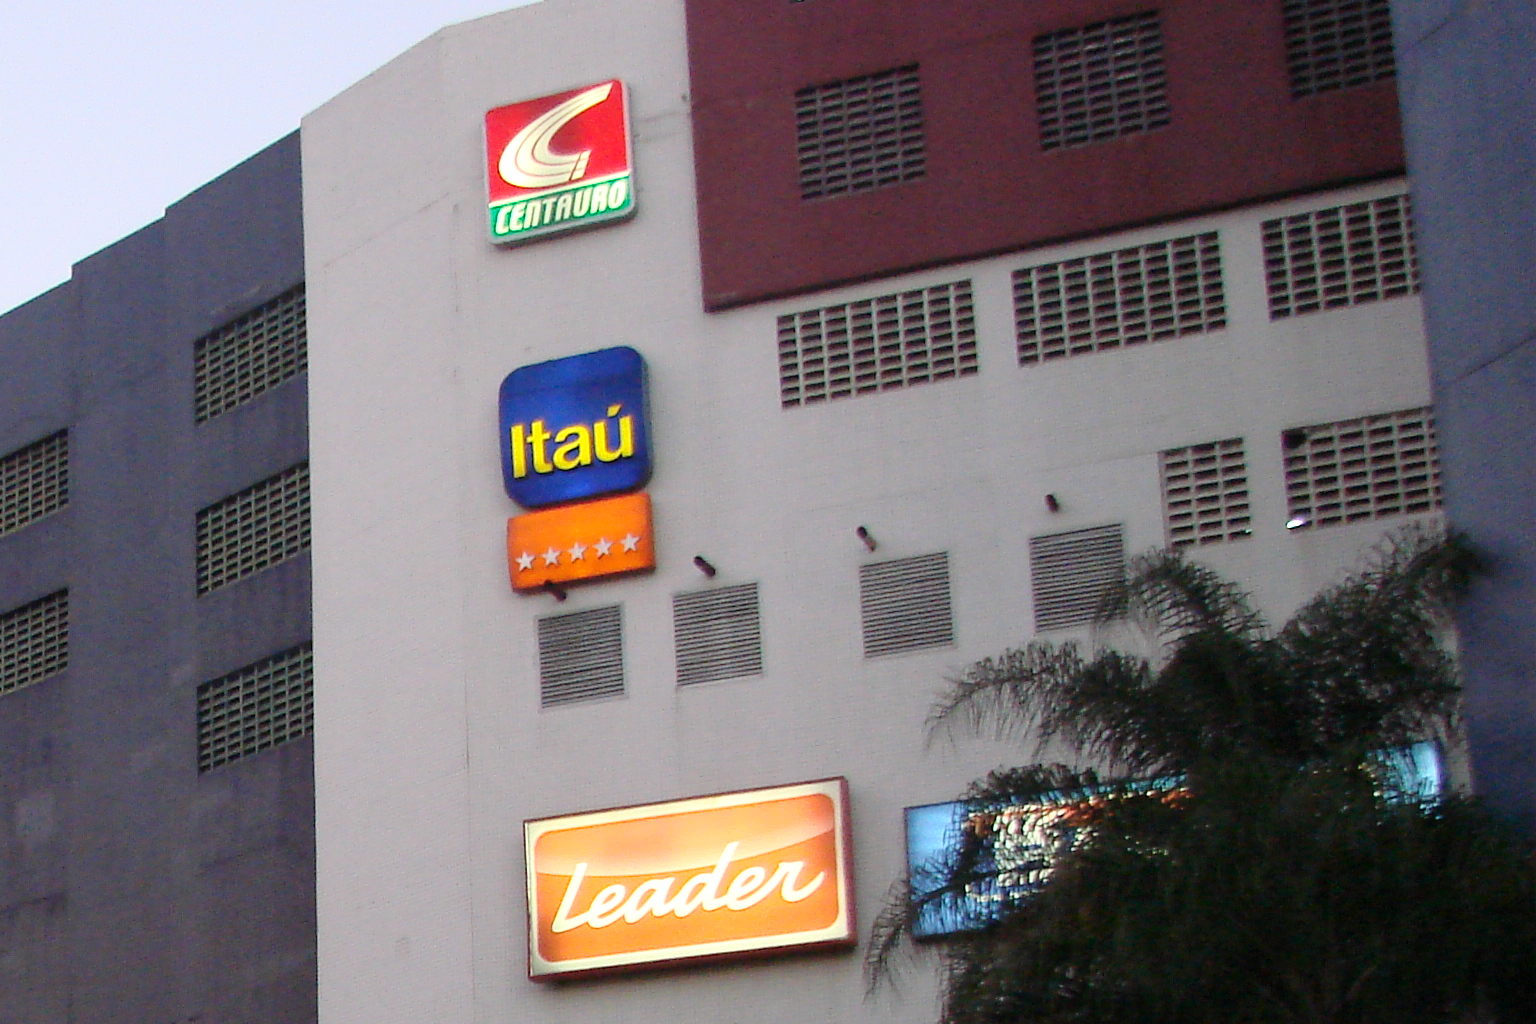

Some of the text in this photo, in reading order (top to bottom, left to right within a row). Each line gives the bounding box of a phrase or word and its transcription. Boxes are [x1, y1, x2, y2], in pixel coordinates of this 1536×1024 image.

[495, 179, 627, 235] CENTAURO
[510, 404, 635, 479] Itaú
[551, 840, 825, 934] Leader
